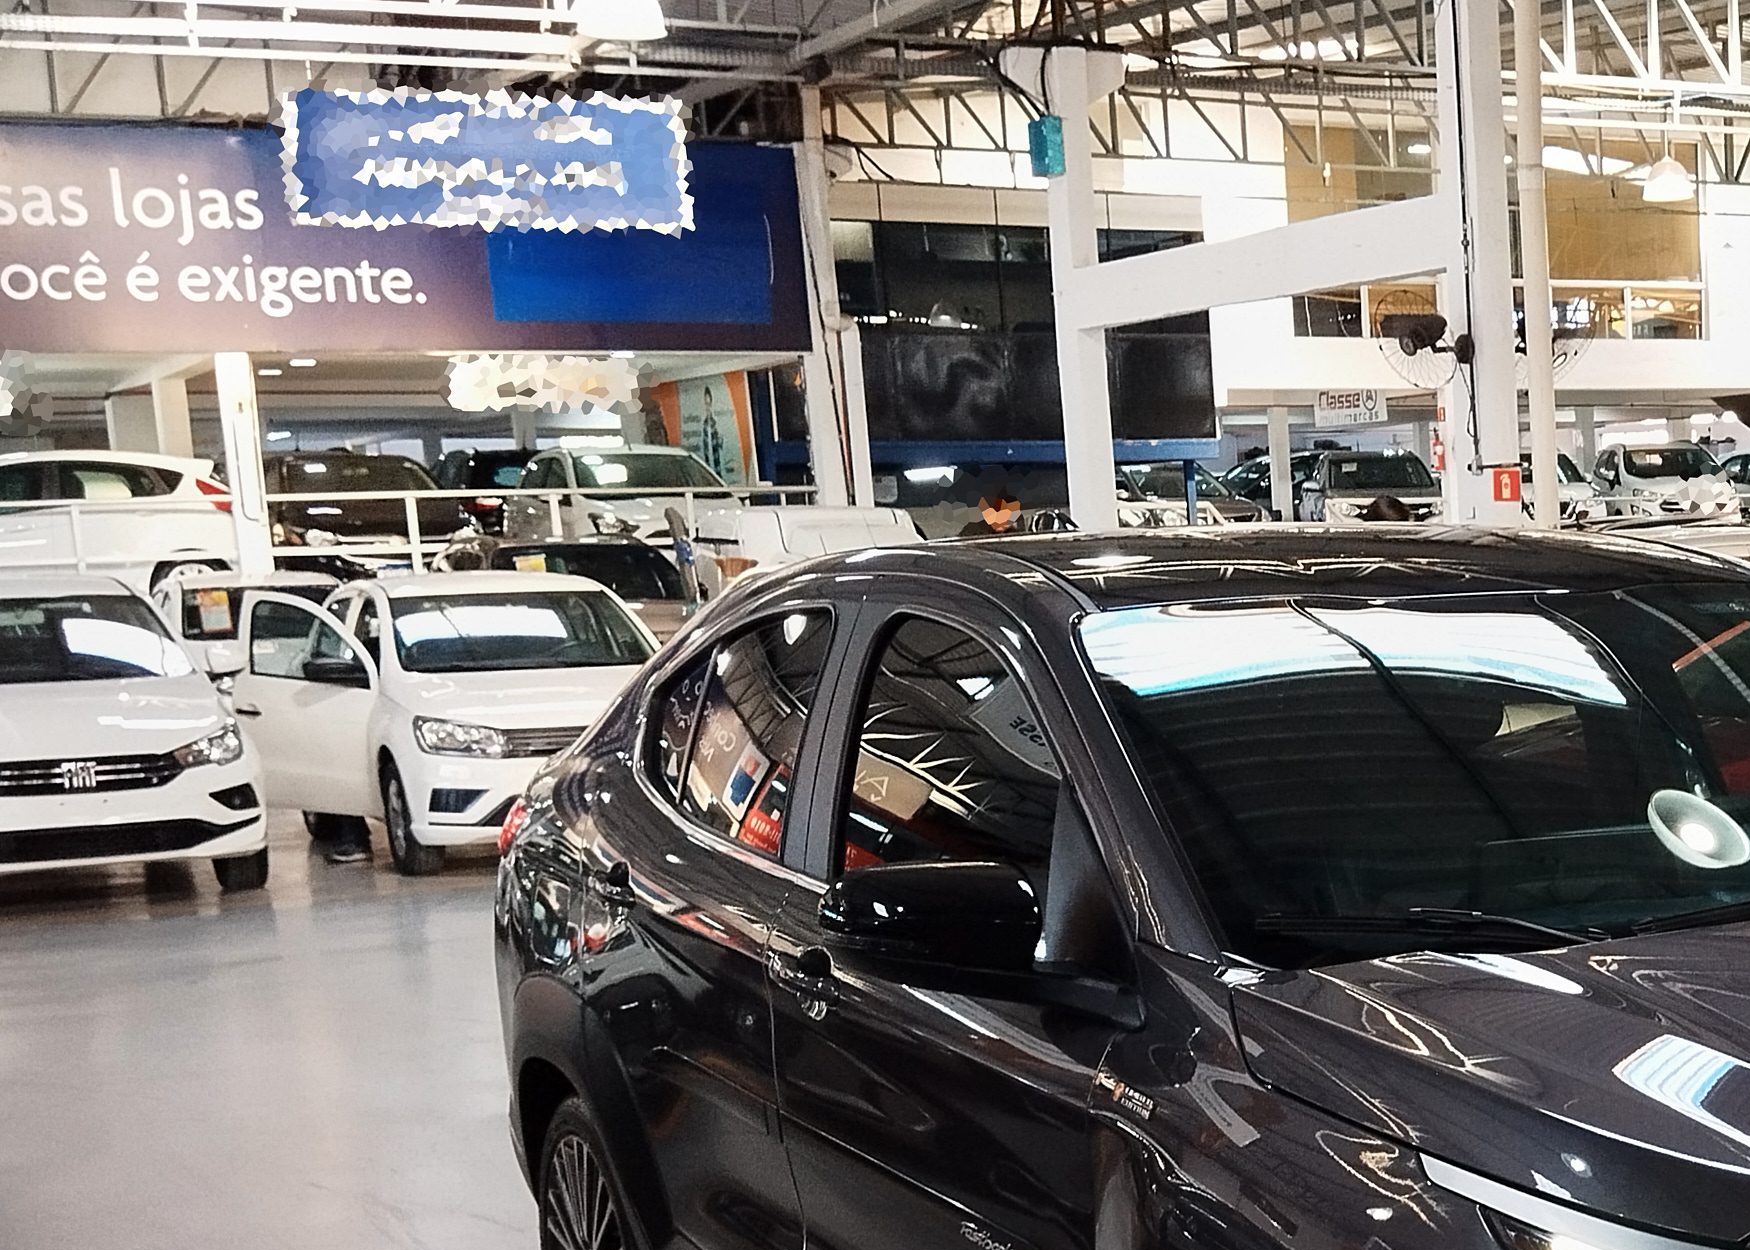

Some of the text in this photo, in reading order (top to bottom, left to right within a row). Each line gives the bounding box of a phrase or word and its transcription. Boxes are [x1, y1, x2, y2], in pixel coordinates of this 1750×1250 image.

[109, 167, 264, 247] lojas
[126, 251, 160, 302] é
[177, 254, 428, 318] exigente.
[1318, 390, 1361, 411] Classe
